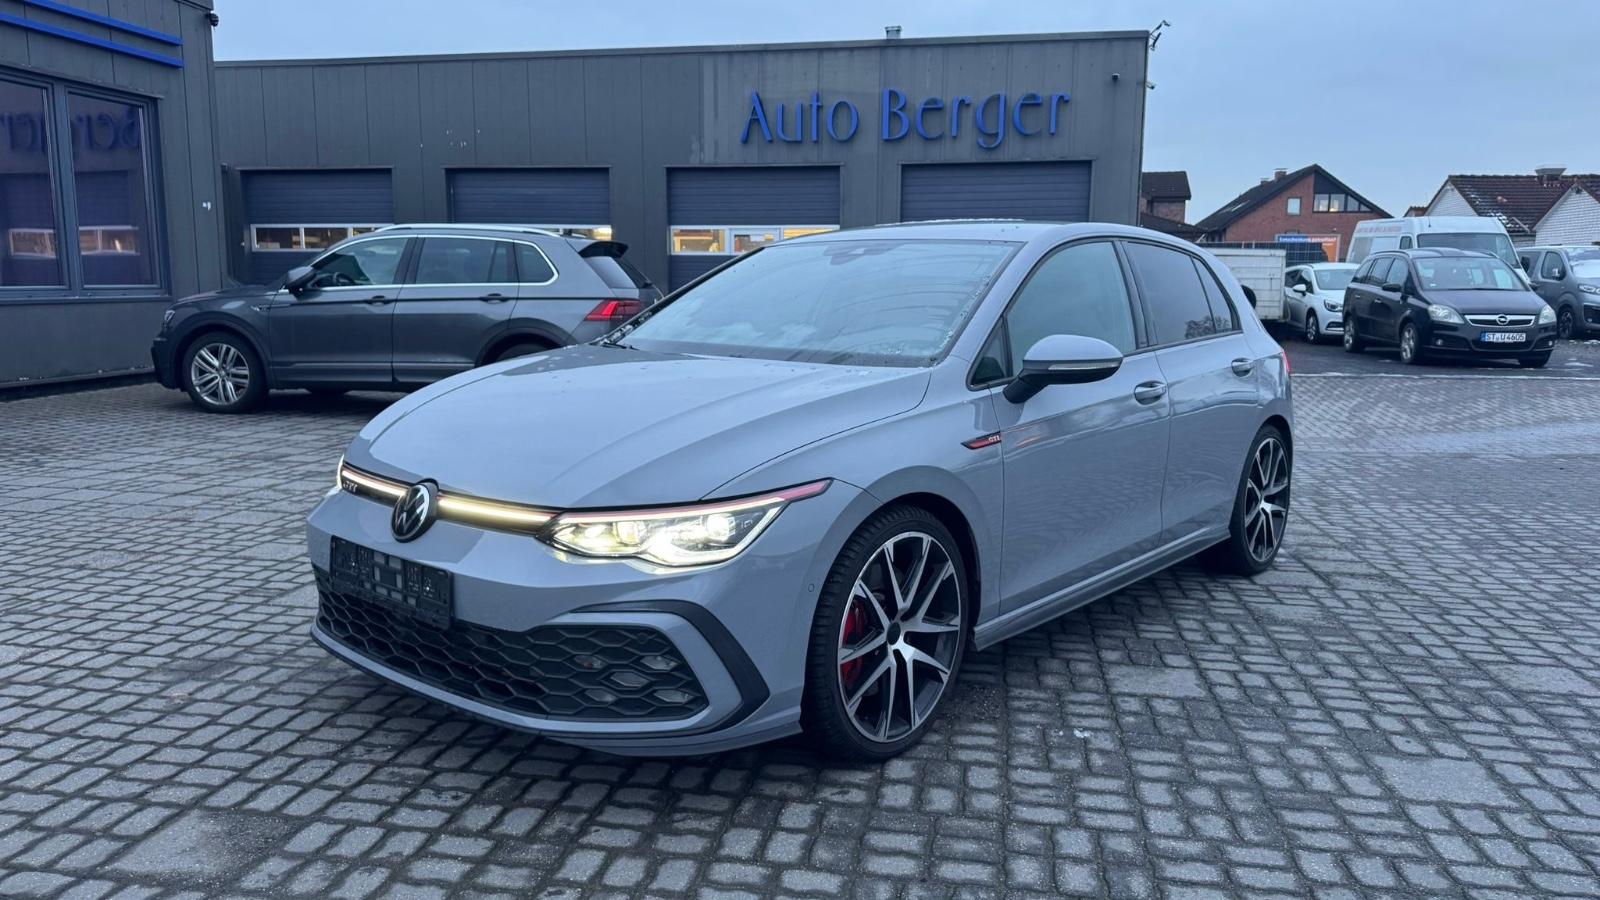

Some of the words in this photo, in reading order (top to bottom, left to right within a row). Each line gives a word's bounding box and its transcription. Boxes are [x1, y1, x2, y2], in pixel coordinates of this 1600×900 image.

[740, 89, 859, 143] Auto
[881, 87, 1071, 149] Berger
[988, 434, 1000, 443] GTI
